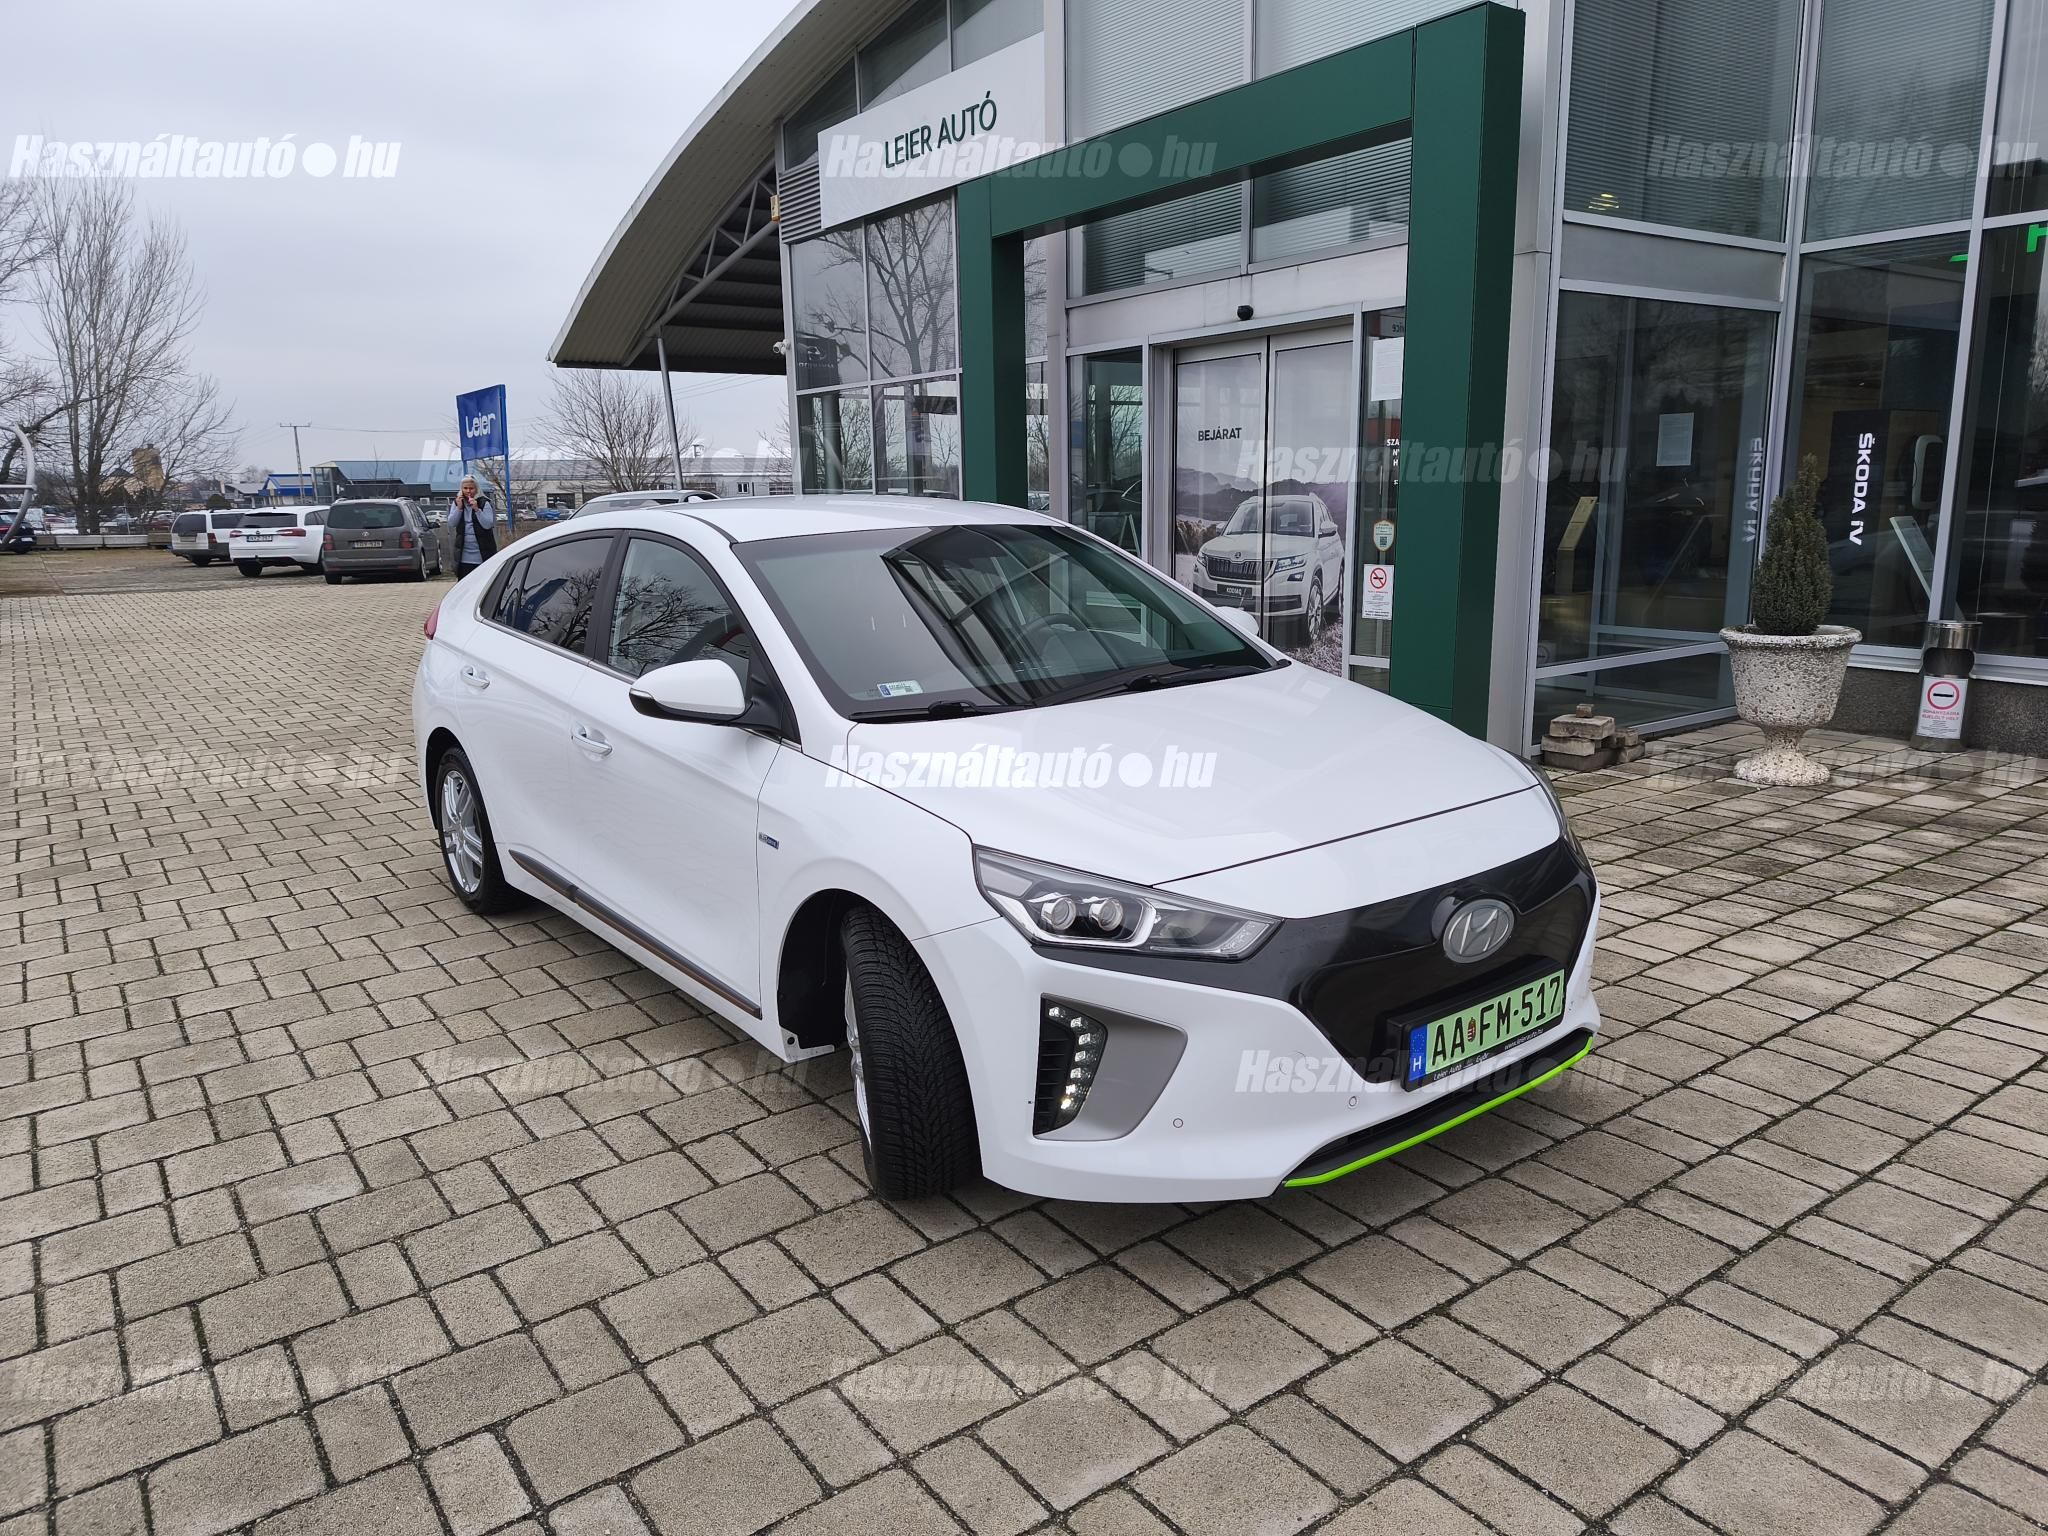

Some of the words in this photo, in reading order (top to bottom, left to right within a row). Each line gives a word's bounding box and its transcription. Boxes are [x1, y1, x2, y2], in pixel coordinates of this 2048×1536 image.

[884, 124, 932, 169] LEIER
[937, 90, 998, 149] AUTÓ
[465, 412, 496, 439] Leier
[1197, 425, 1243, 442] BEJÁRAT
[1852, 432, 1876, 514] ŠKODA
[1413, 1055, 1422, 1072] H
